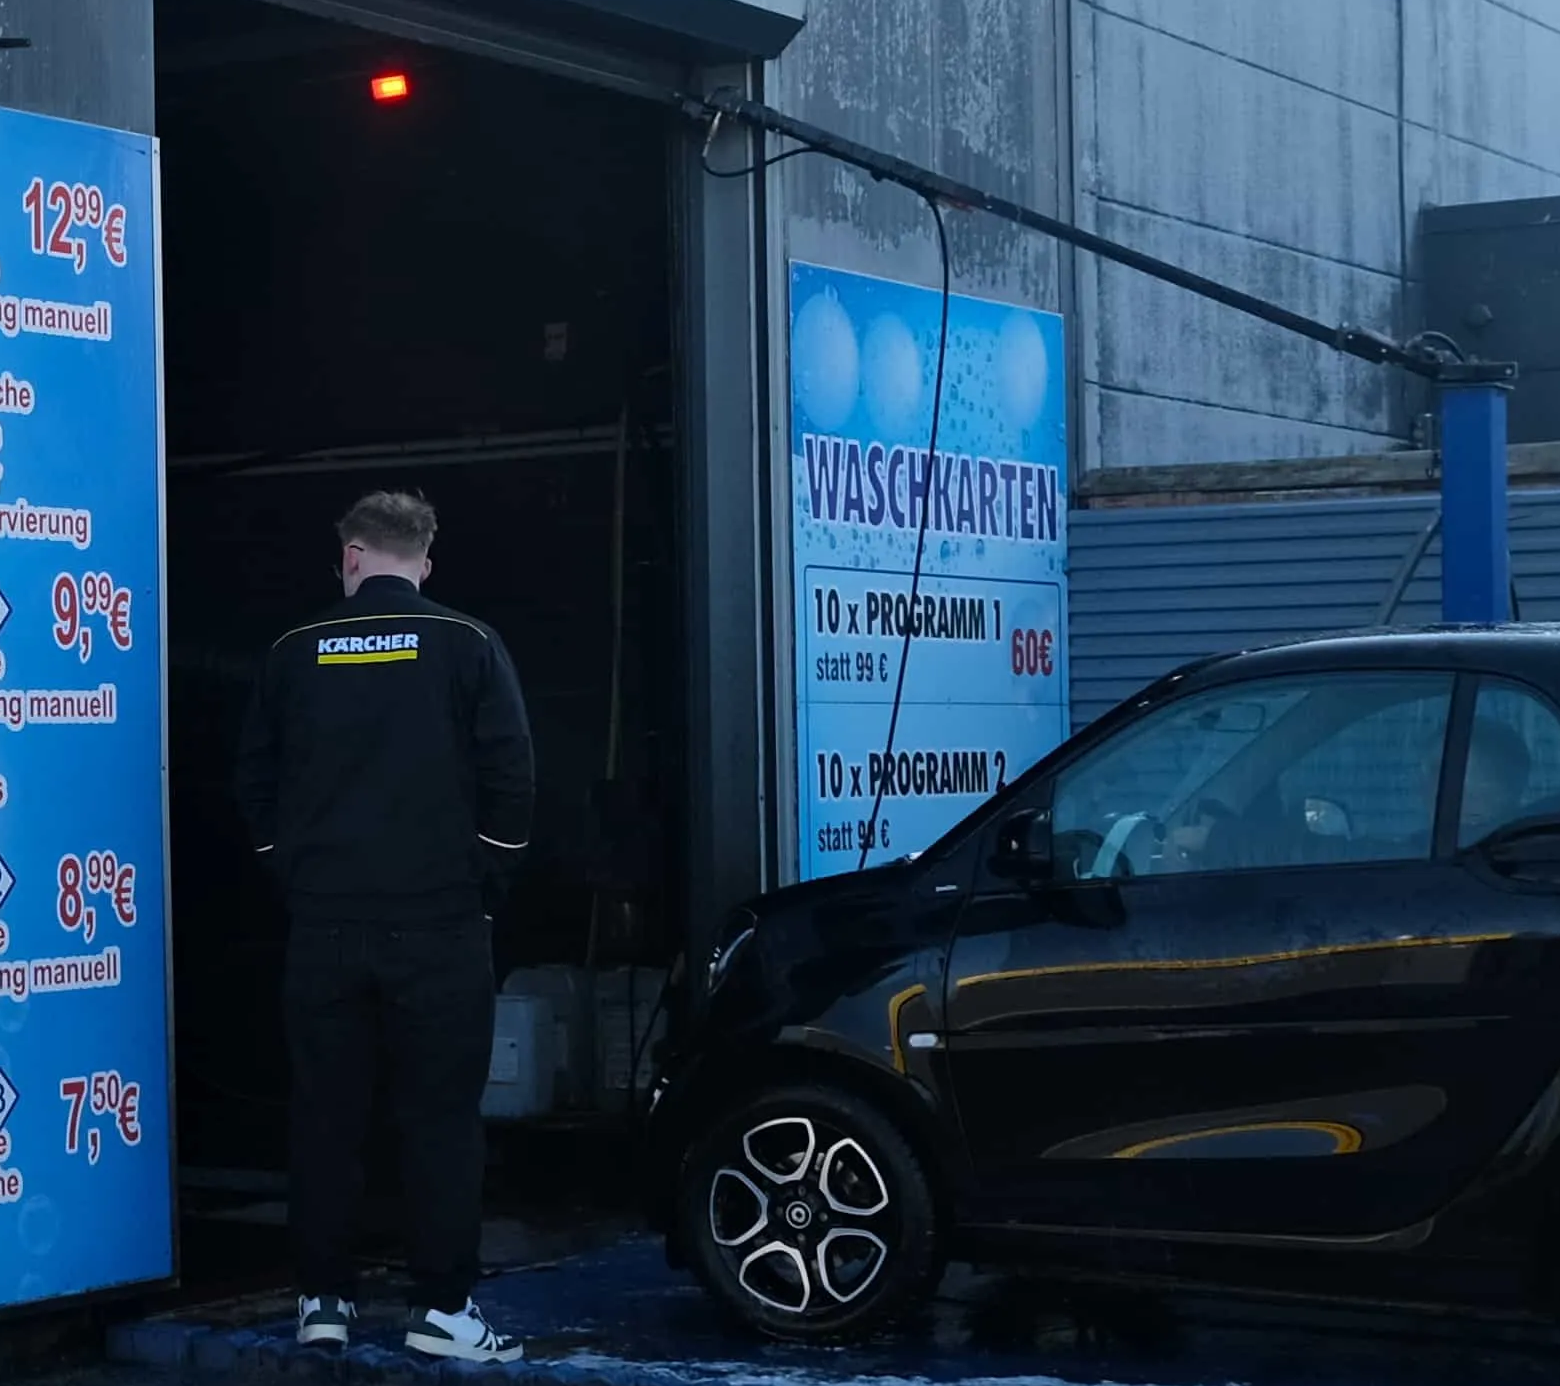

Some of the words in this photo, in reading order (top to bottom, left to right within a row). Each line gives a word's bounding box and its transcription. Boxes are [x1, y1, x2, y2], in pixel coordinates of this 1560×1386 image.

[24, 301, 108, 335] manuell
[804, 434, 1058, 542] WASCHKARTEN
[815, 588, 839, 634] 10
[848, 604, 858, 634] x
[866, 592, 985, 640] PROGRAMM
[994, 600, 1000, 640] 1
[318, 633, 418, 654] KÄRCHER
[1012, 628, 1053, 676] 60€
[817, 652, 850, 681] statt
[30, 689, 113, 718] manuell
[817, 753, 843, 798] 10
[850, 766, 862, 797] x
[869, 751, 988, 796] PROGRAMM
[995, 751, 1006, 793] 2
[818, 820, 852, 852] statt
[33, 953, 117, 987] manuell
